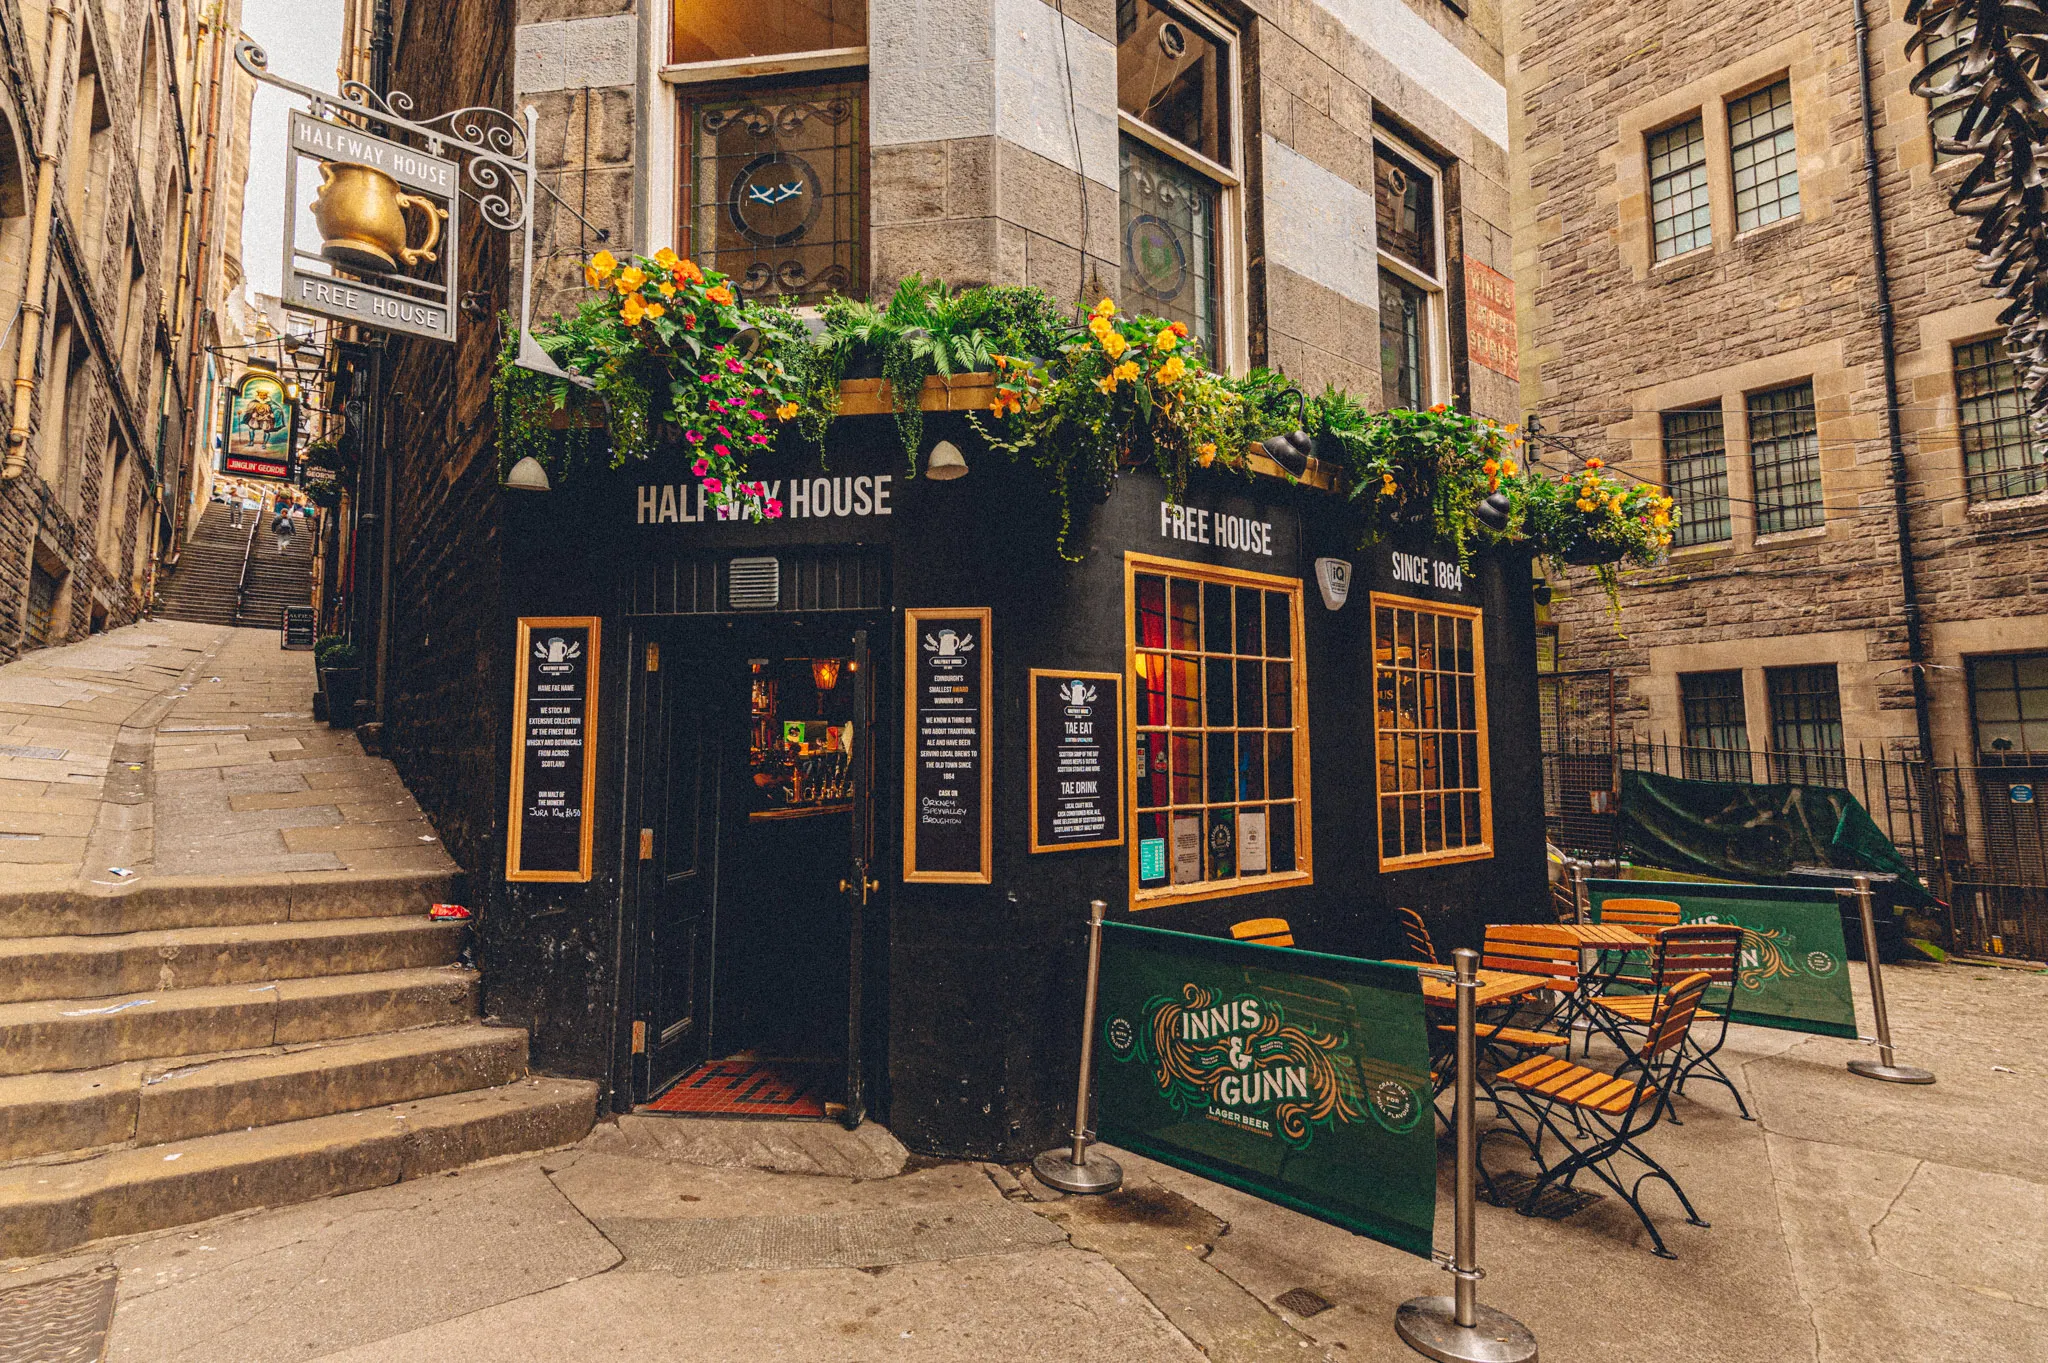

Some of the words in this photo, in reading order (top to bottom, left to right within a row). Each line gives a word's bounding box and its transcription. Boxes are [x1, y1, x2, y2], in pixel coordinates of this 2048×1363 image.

[300, 124, 384, 165] HALFWAY
[394, 154, 446, 186] HOUSE
[302, 279, 358, 310] FREE
[373, 297, 438, 329] HOUSE
[1469, 268, 1511, 309] WINES
[1469, 329, 1518, 367] SPIRITS
[229, 460, 257, 471] JINGLIN'
[258, 463, 286, 475] GEORDIE
[790, 475, 892, 518] HOUSE
[1160, 501, 1209, 544] FREE
[1214, 512, 1272, 556] HOUSE
[1392, 551, 1429, 586] SINCE
[1433, 560, 1463, 592] 1864
[1065, 722, 1078, 734] TAE
[1080, 722, 1093, 734] EAT
[1061, 782, 1074, 794] TAE
[1076, 781, 1097, 793] DRINK
[529, 807, 548, 816] JURA
[922, 815, 961, 824] BROUGHTON
[1183, 999, 1260, 1040] INNIS
[1230, 1036, 1252, 1070] &
[1221, 1066, 1309, 1105] GUNN
[1379, 1081, 1406, 1095] CRAFTED
[1209, 1106, 1240, 1122] LAGER
[1242, 1115, 1269, 1130] BEER
[1377, 1096, 1386, 1113] FULL
[1387, 1103, 1409, 1118] FLAVOUR
